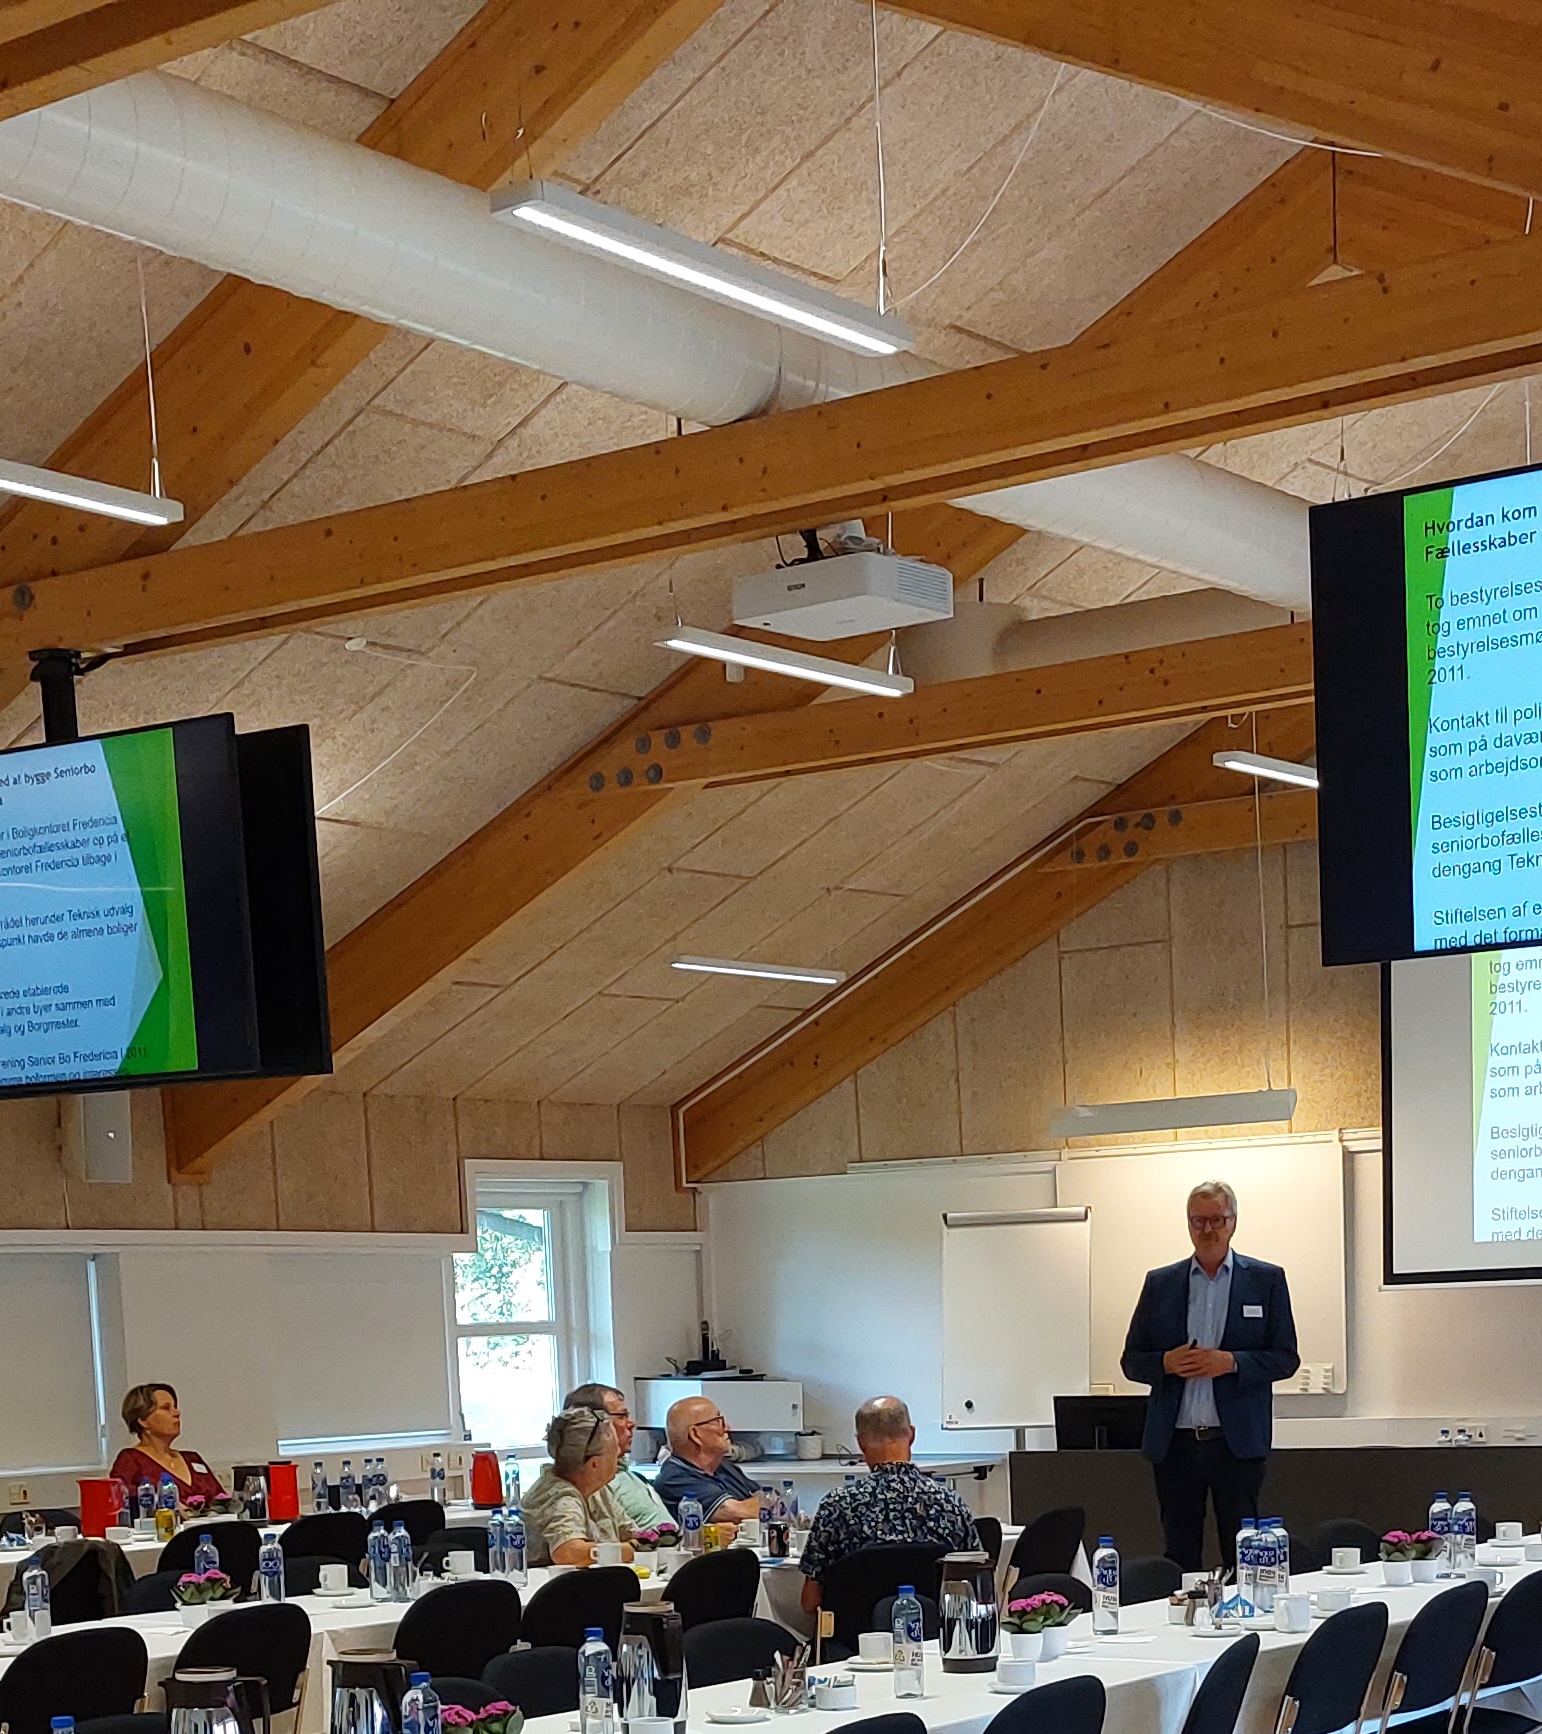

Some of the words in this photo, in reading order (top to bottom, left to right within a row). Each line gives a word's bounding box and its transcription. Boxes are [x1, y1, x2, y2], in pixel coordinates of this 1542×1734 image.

[1423, 513, 1495, 537] Hvordan
[1501, 506, 1537, 523] kom
[1425, 531, 1537, 562] Fællesskaber
[1426, 593, 1444, 610] To
[1425, 620, 1450, 637] tog
[1456, 607, 1508, 630] emnet
[1512, 606, 1537, 621] om
[1428, 711, 1490, 734] Kontakt
[1495, 707, 1507, 725] til
[1428, 742, 1463, 757] som
[1468, 734, 1487, 756] på
[1429, 766, 1463, 781] som
[1431, 859, 1501, 879] dengang
[1433, 903, 1506, 923] Stiftelsen
[1511, 898, 1528, 915] af
[1488, 961, 1511, 976] tog
[1489, 1065, 1520, 1077] som
[1524, 1060, 1541, 1079] på
